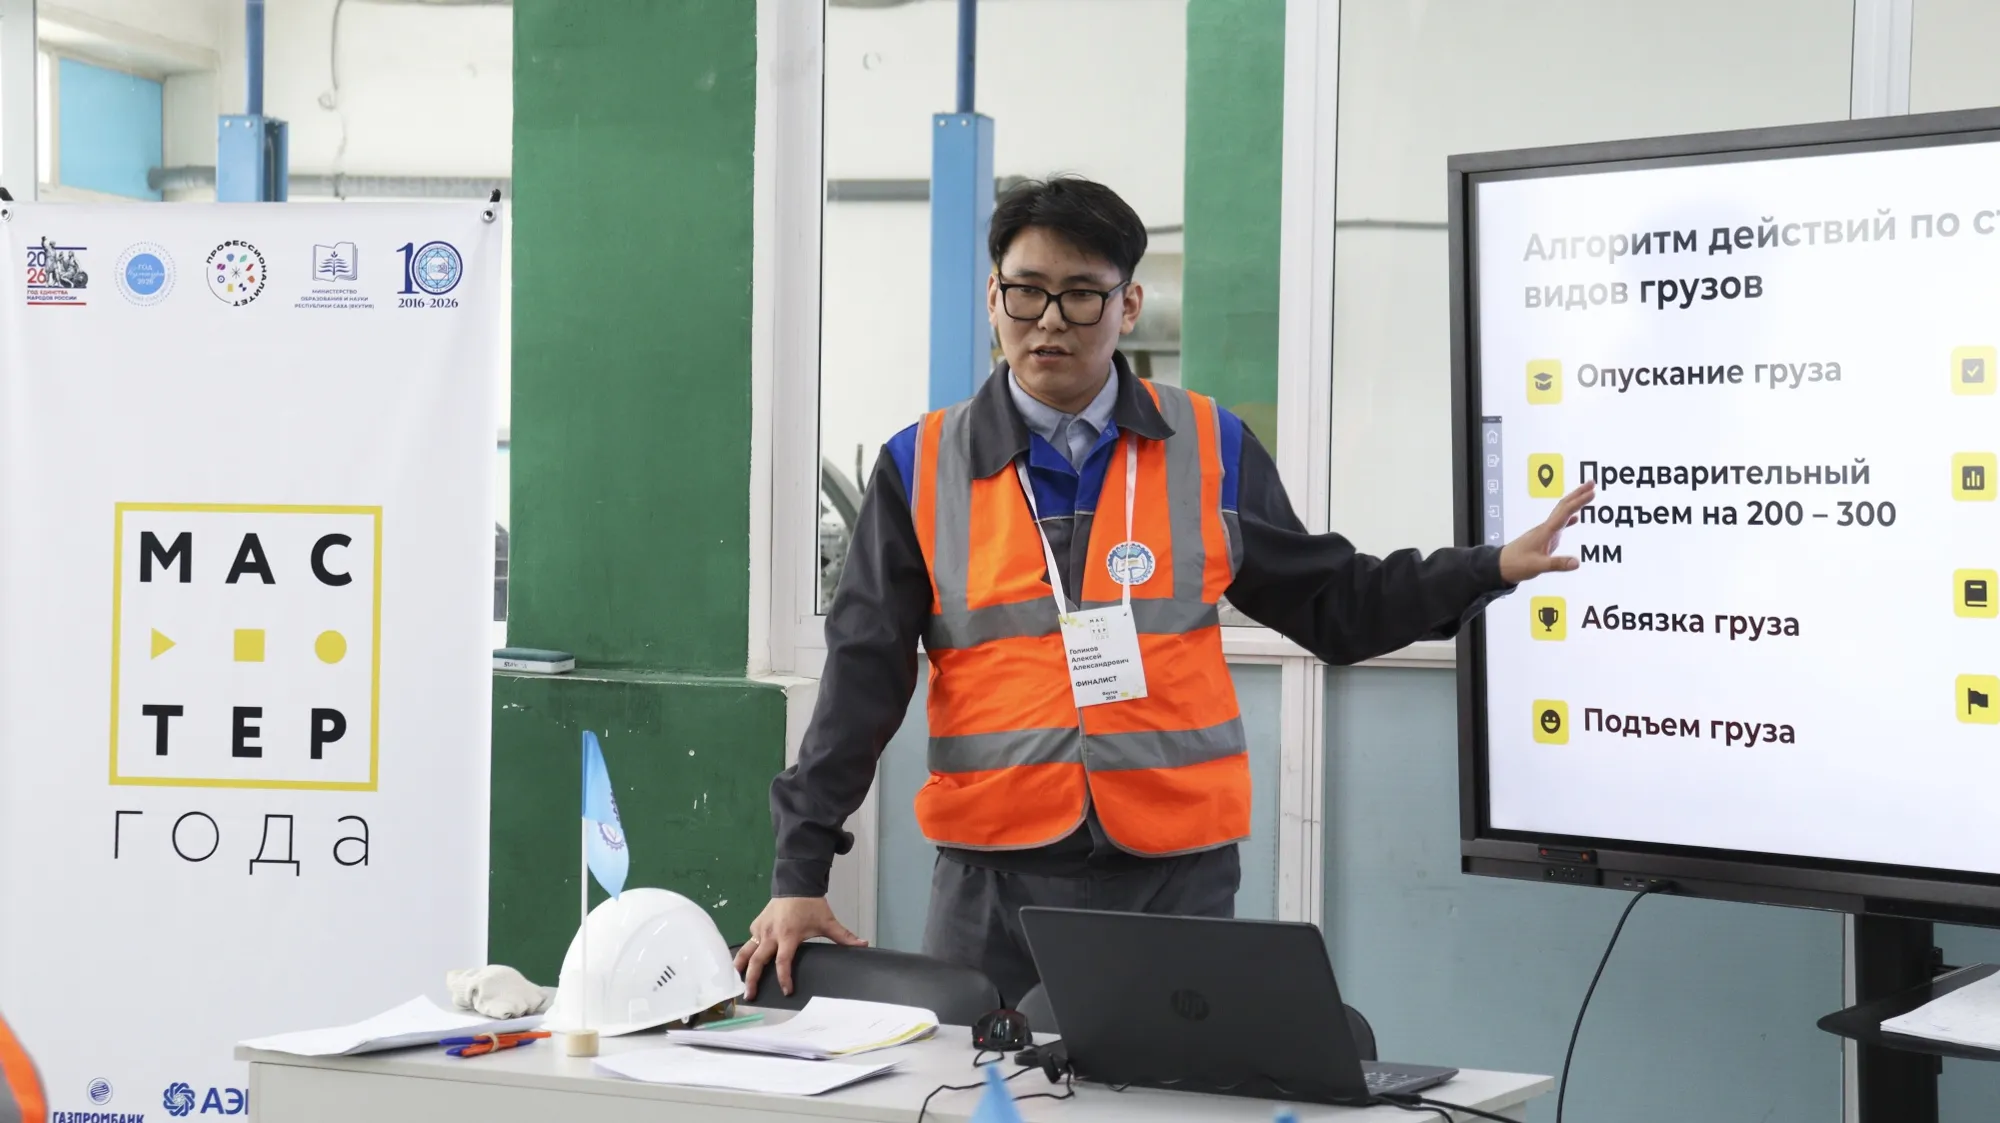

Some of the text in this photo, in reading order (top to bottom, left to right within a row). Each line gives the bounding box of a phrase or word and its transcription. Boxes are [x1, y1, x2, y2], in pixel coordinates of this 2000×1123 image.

[1522, 209, 2000, 264] Алгоритм действий по с
[27, 251, 47, 267] 20
[206, 240, 267, 307] ПРОФЕССИОНАЛИТЕТ
[27, 268, 46, 284] 26
[398, 298, 459, 308] 2016-2026
[1524, 275, 1764, 311] видов грузов
[1577, 358, 1842, 393] Опускание груза
[1578, 458, 1871, 489] Предварительный
[1579, 502, 1693, 528] подъем
[1702, 505, 1738, 526] на
[1746, 500, 1804, 526] 200
[1836, 501, 1897, 527] 300
[140, 531, 353, 586] МАС
[1580, 545, 1622, 563] мм
[1581, 604, 1800, 641] Абвязка груза
[1069, 646, 1098, 655] Голиков
[1071, 653, 1101, 663] Алексей
[1073, 658, 1129, 671] Александрович
[1075, 676, 1117, 687] ФИНАЛИСТ
[142, 704, 347, 760] ТЕР
[1584, 707, 1796, 748] Подъем груза
[114, 810, 370, 876] года
[53, 1112, 145, 1123] ГАЗПРОМБАНК
